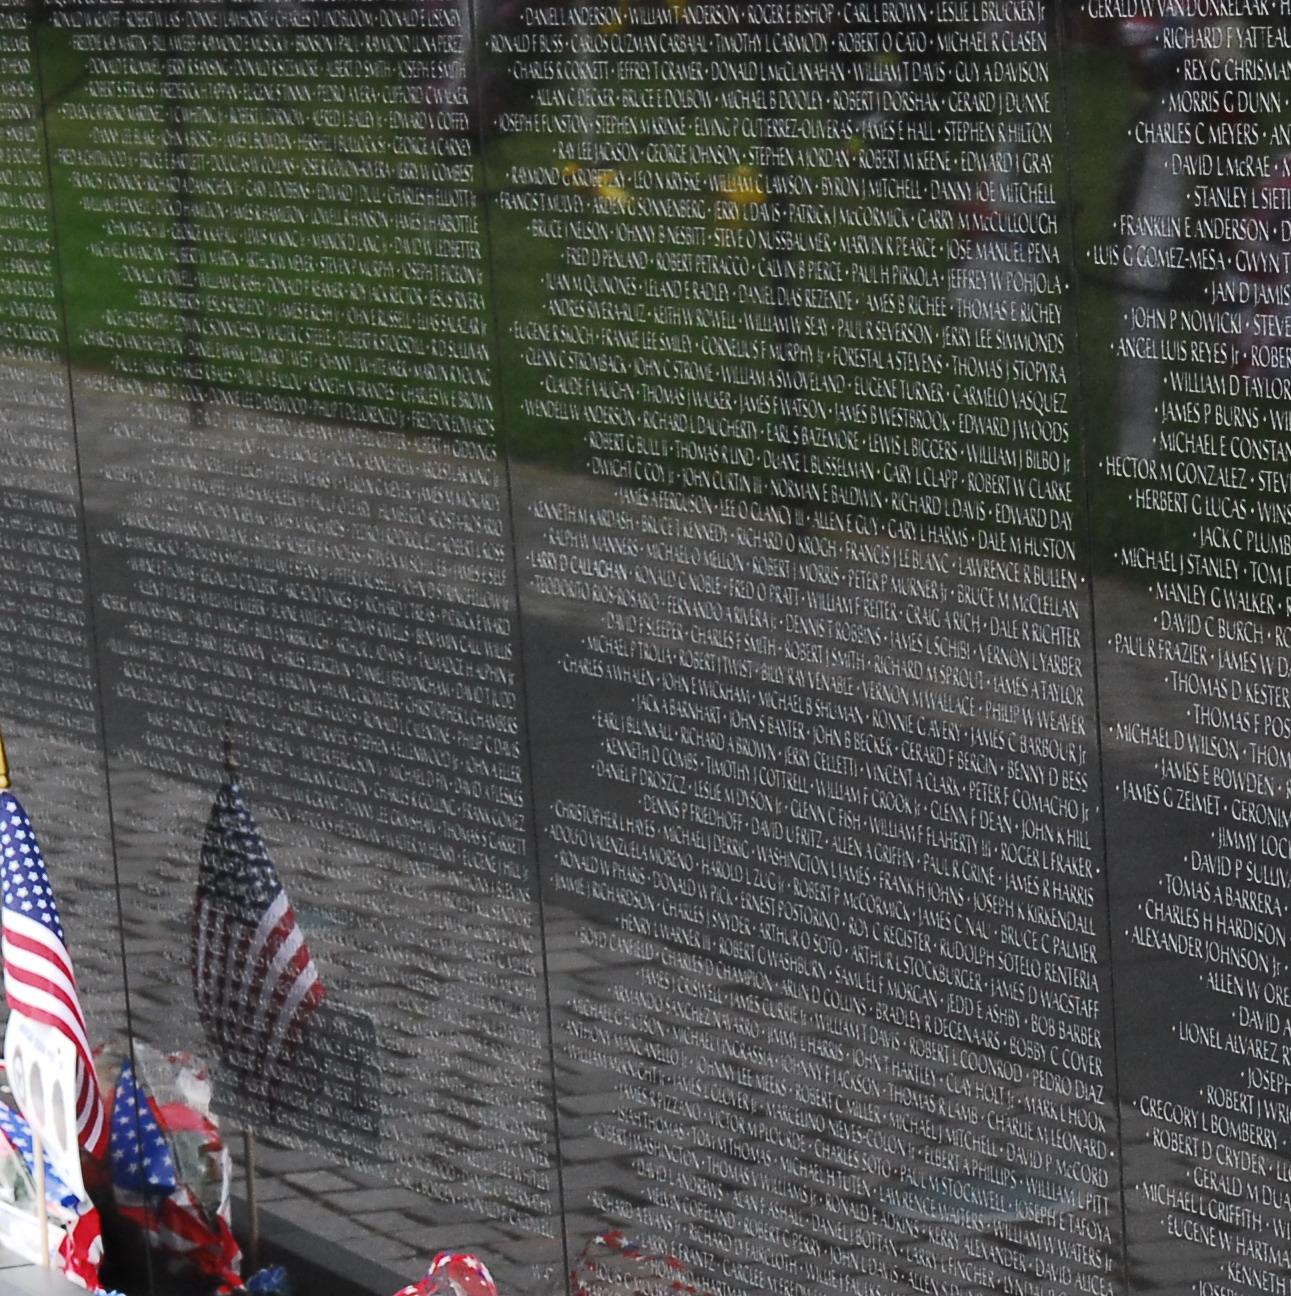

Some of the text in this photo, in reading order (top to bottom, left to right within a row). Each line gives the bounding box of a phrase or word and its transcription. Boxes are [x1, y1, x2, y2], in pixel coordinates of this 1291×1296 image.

[956, 61, 1048, 82] GUY A DAVISON
[1169, 91, 1281, 113] MORRIS G DUNN
[945, 121, 1052, 143] STEPHEN R HILTON
[974, 892, 1096, 936] JOSEPH K KIRKENDALL
[1001, 925, 1097, 964] BRUCE C PALMER
[1036, 1258, 1071, 1285] DAVID
